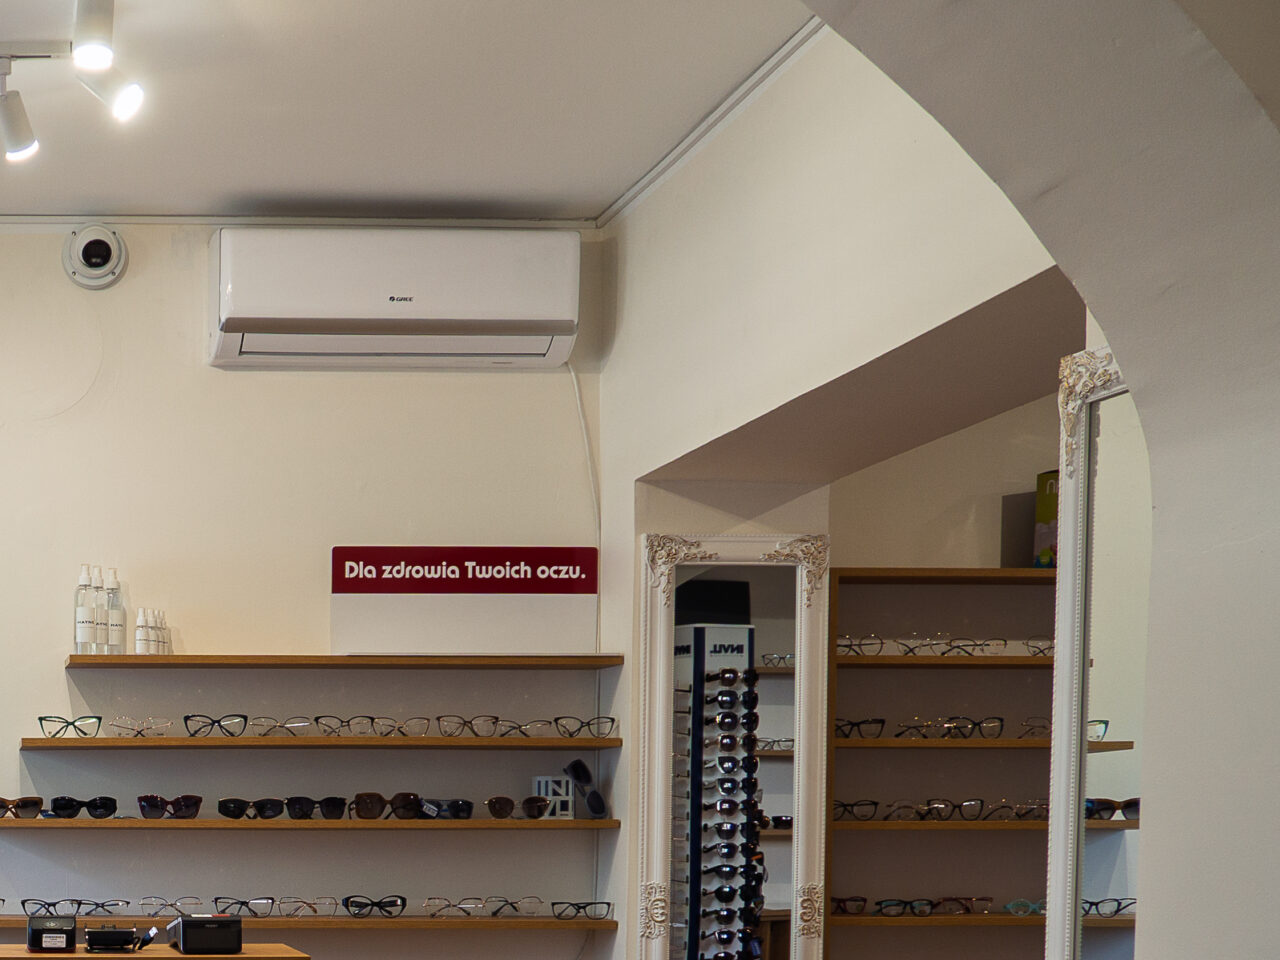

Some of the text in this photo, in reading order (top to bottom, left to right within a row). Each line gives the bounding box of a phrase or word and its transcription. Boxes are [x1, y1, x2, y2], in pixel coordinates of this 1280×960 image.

[344, 561, 587, 579] Dla zdrowia Twoich oczu.
